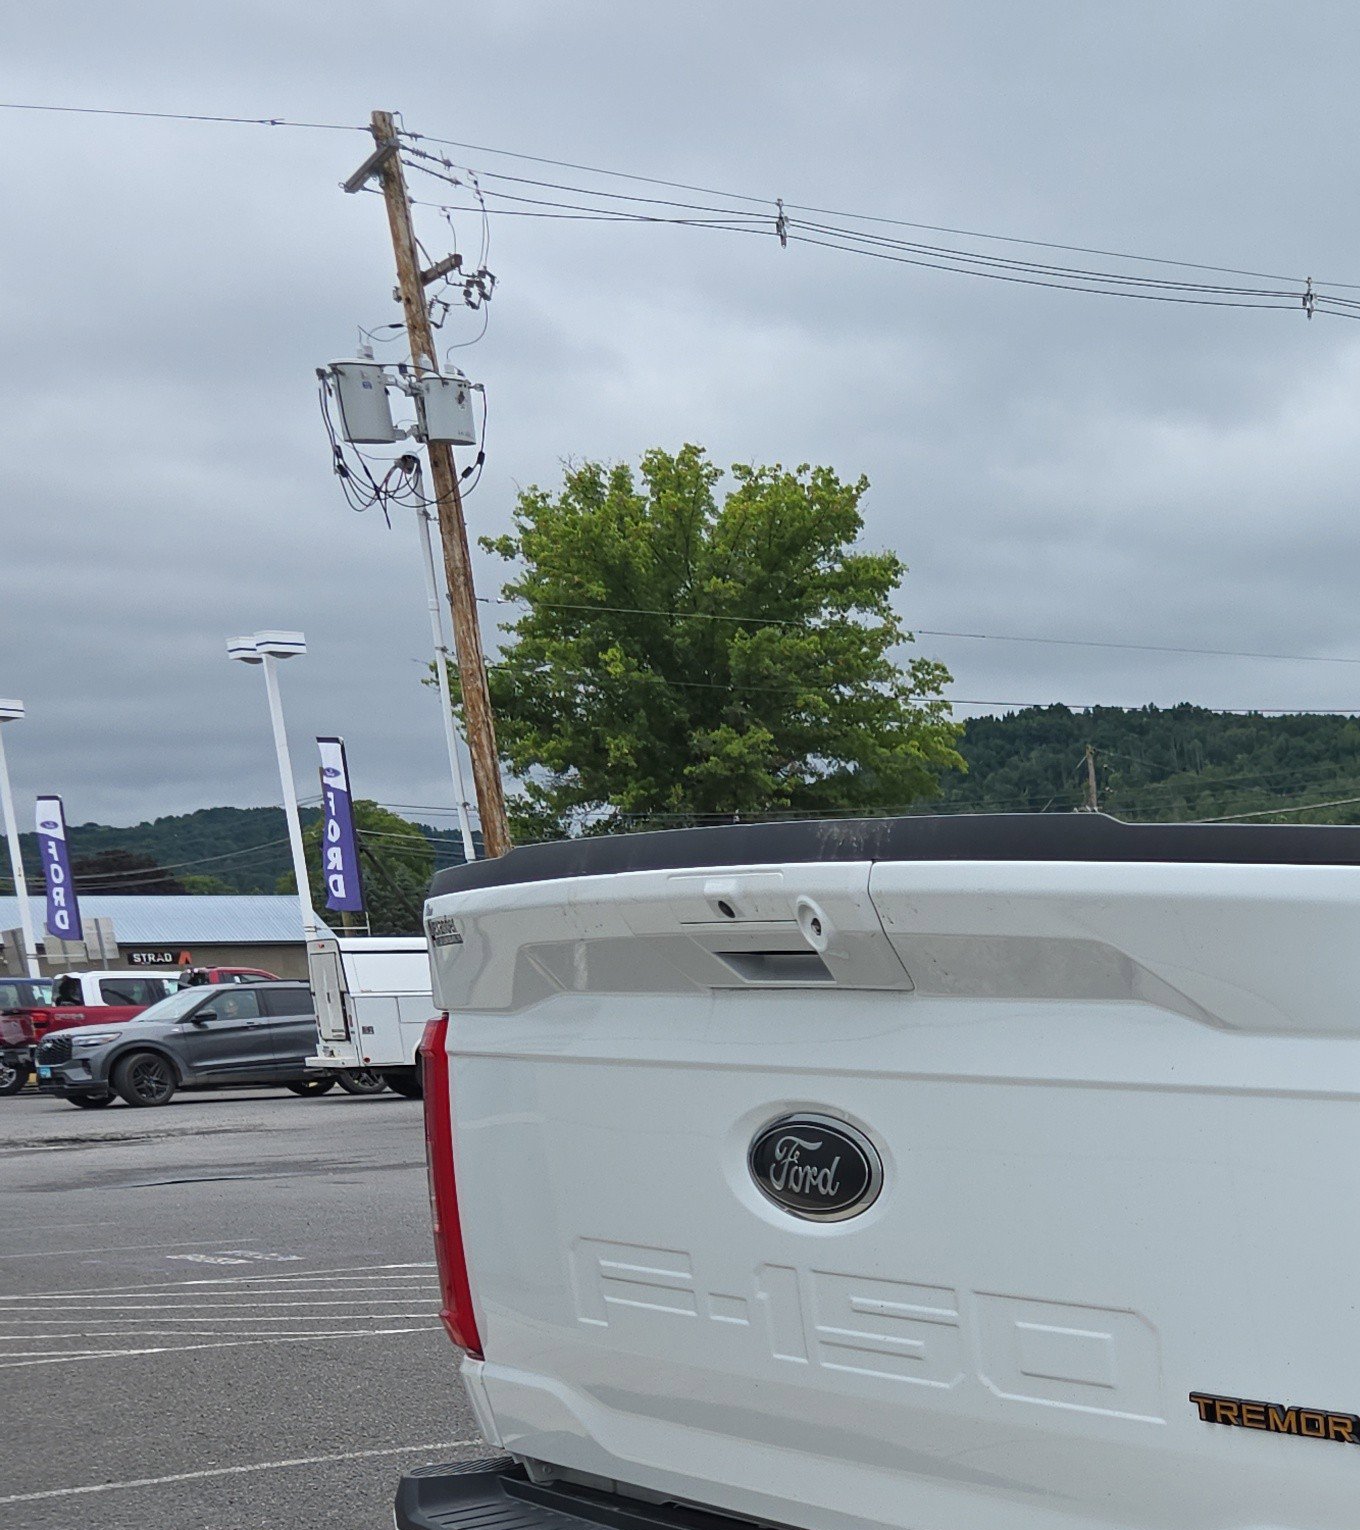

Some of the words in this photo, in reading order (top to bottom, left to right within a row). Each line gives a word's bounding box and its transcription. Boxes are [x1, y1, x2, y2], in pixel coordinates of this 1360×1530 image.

[132, 952, 173, 963] STRAD
[770, 1135, 841, 1196] Ford
[568, 1234, 1168, 1425] F-150
